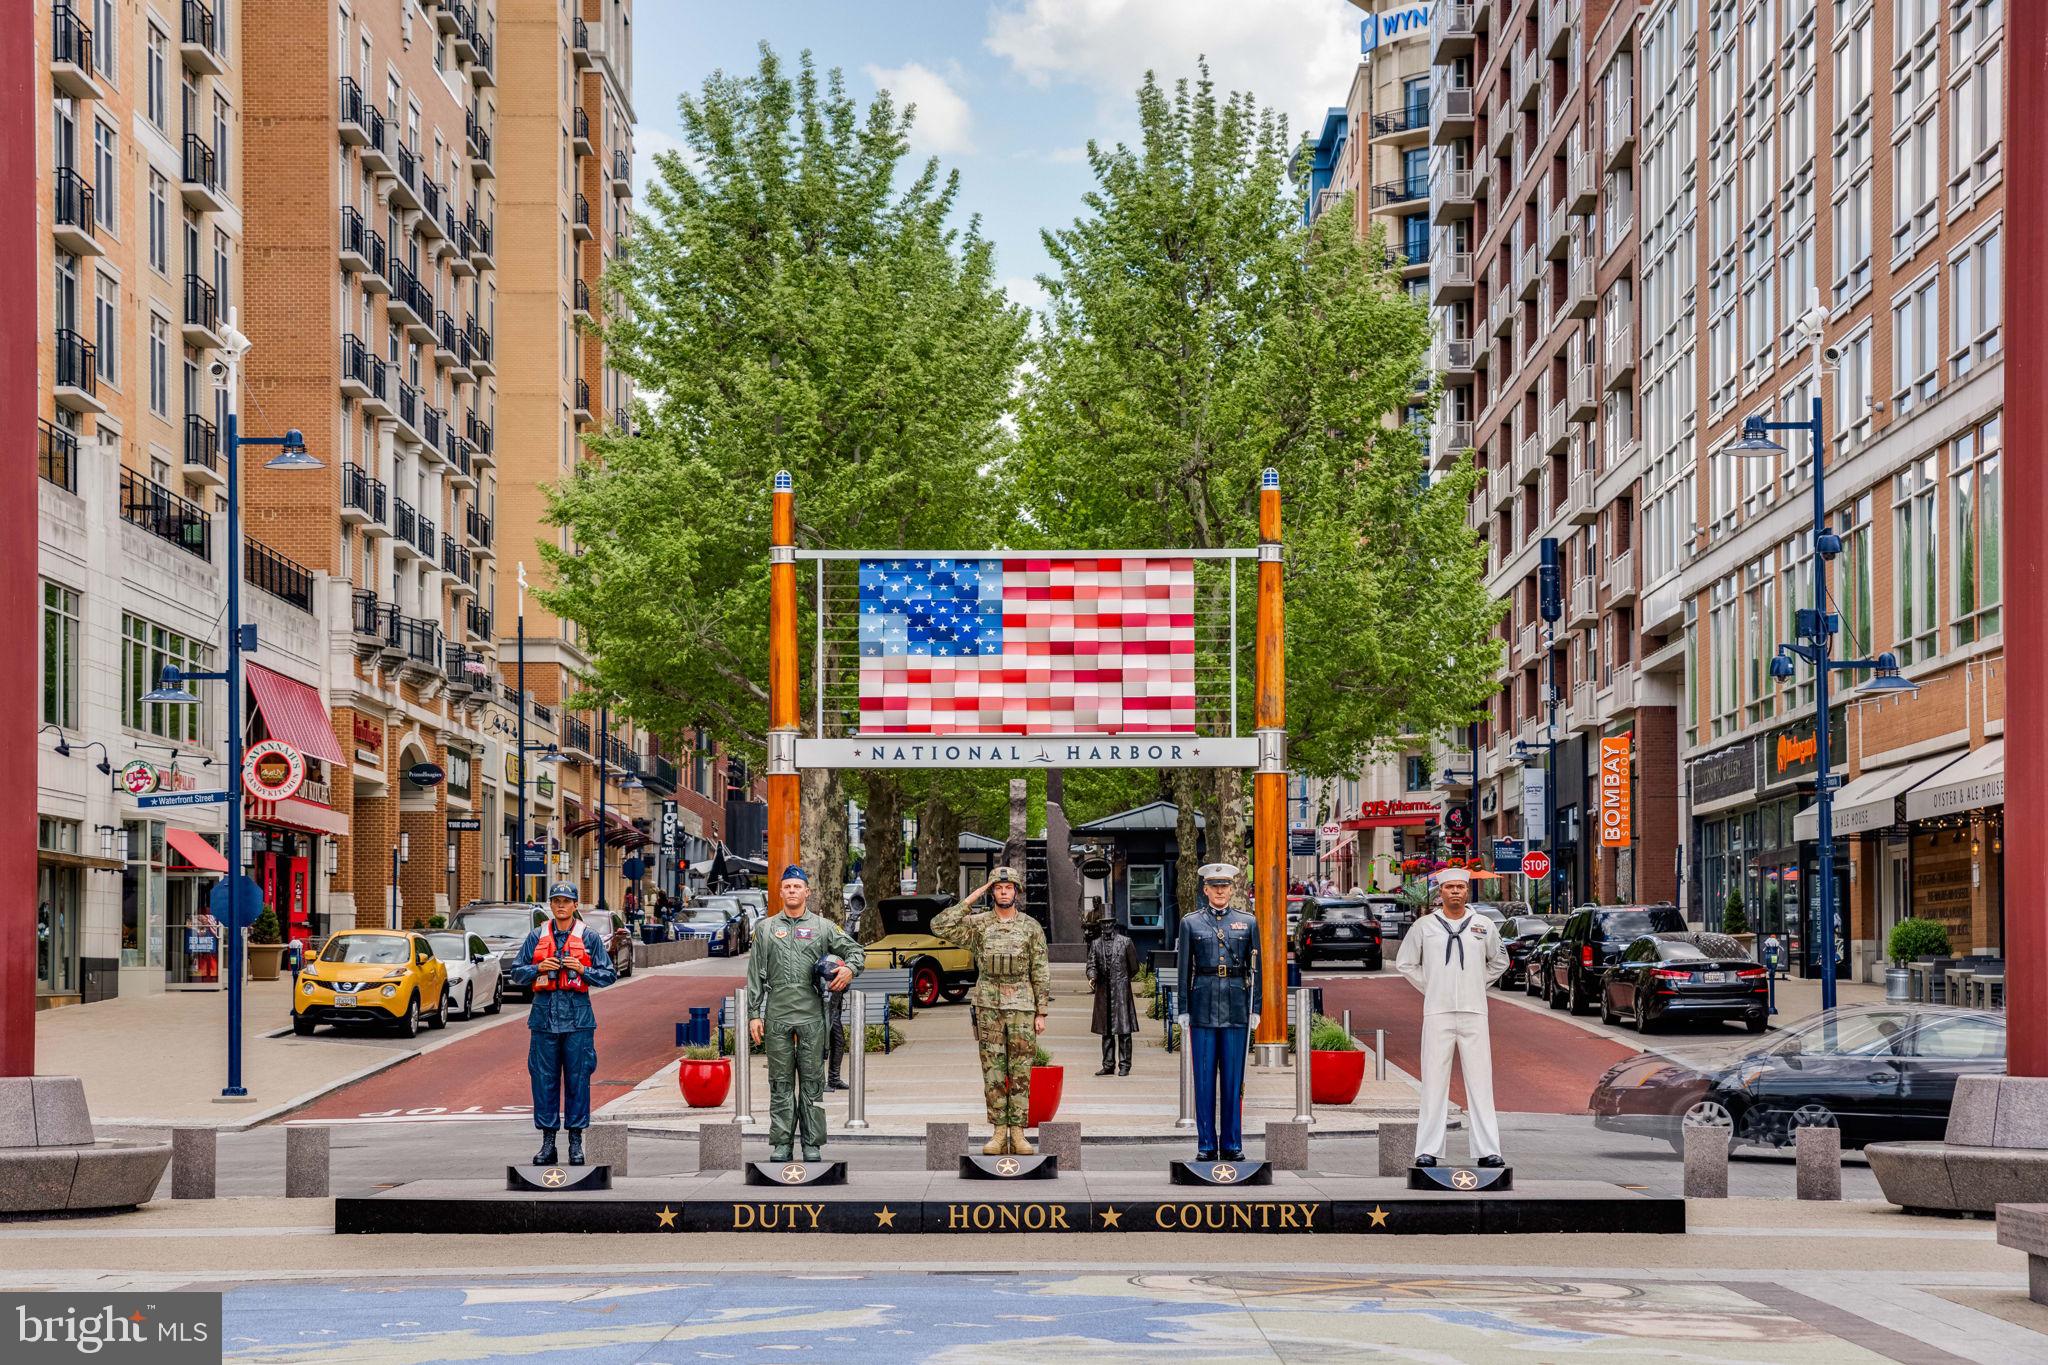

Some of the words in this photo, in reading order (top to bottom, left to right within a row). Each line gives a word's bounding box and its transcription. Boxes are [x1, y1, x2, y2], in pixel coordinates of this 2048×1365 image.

[246, 743, 300, 768] SAVANNAH'S
[871, 746, 1020, 760] NATIONAL
[1067, 746, 1183, 760] HARBOR
[1621, 748, 1629, 784] FOOD
[159, 796, 194, 805] Waterfront
[194, 794, 214, 803] Street
[1603, 745, 1620, 840] BOMBAY
[1933, 791, 1956, 808] OYSTER
[1959, 791, 1964, 803] &
[1967, 786, 1978, 801] ALE
[1981, 780, 2004, 798] HOUSE
[461, 821, 479, 829] DROP
[1621, 790, 1629, 836] STREET
[1840, 814, 1850, 827] ALE
[1851, 810, 1868, 825] HOUSE
[1523, 860, 1549, 871] STOP
[358, 1105, 534, 1118] STOP
[733, 1204, 825, 1229] DUTY
[949, 1204, 1070, 1229] HONOR
[1155, 1203, 1320, 1229] COUNTRY
